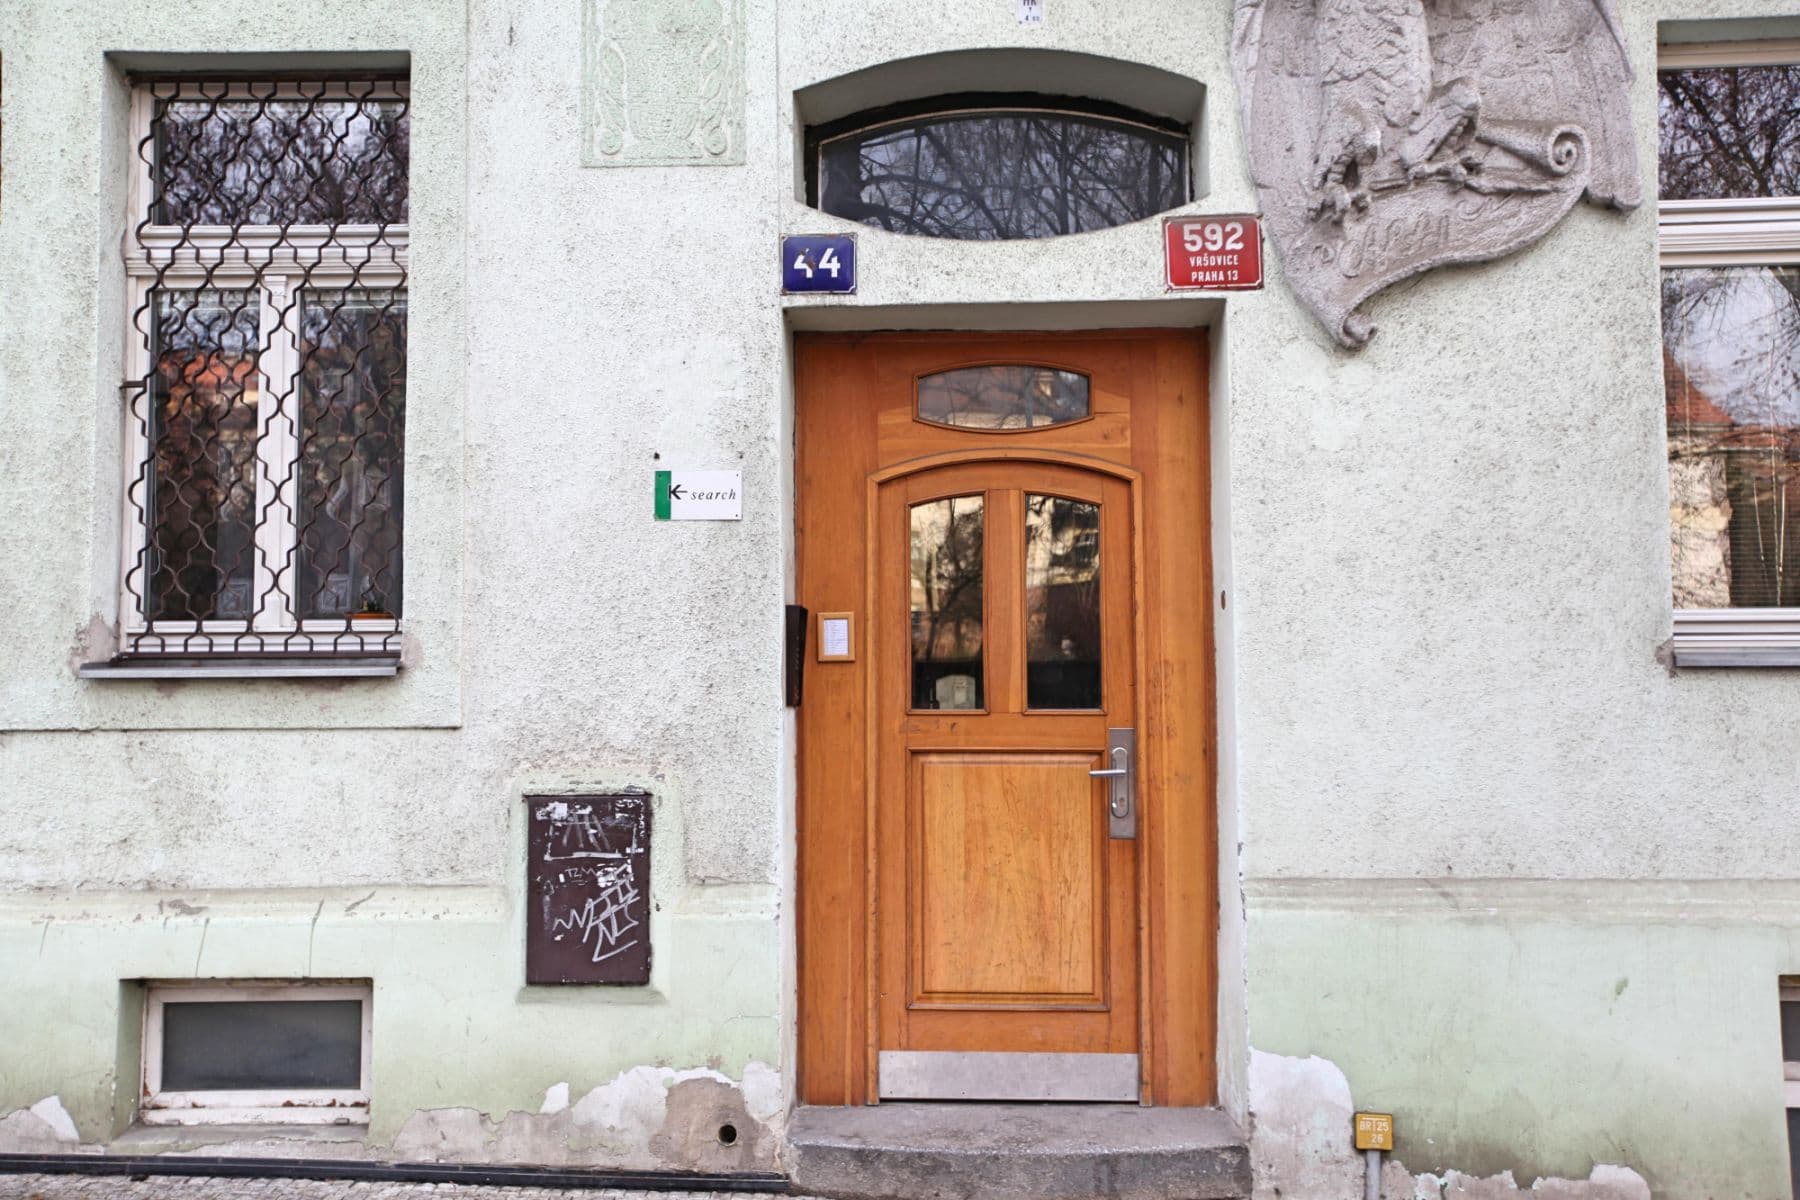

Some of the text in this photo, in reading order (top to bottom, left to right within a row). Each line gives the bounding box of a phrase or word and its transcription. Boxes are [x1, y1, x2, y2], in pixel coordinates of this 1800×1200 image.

[1183, 222, 1244, 252] 592
[793, 247, 841, 278] 44
[1189, 253, 1239, 267] VRŠOVICE
[1191, 269, 1239, 282] PRAHA 13
[690, 488, 736, 500] search
